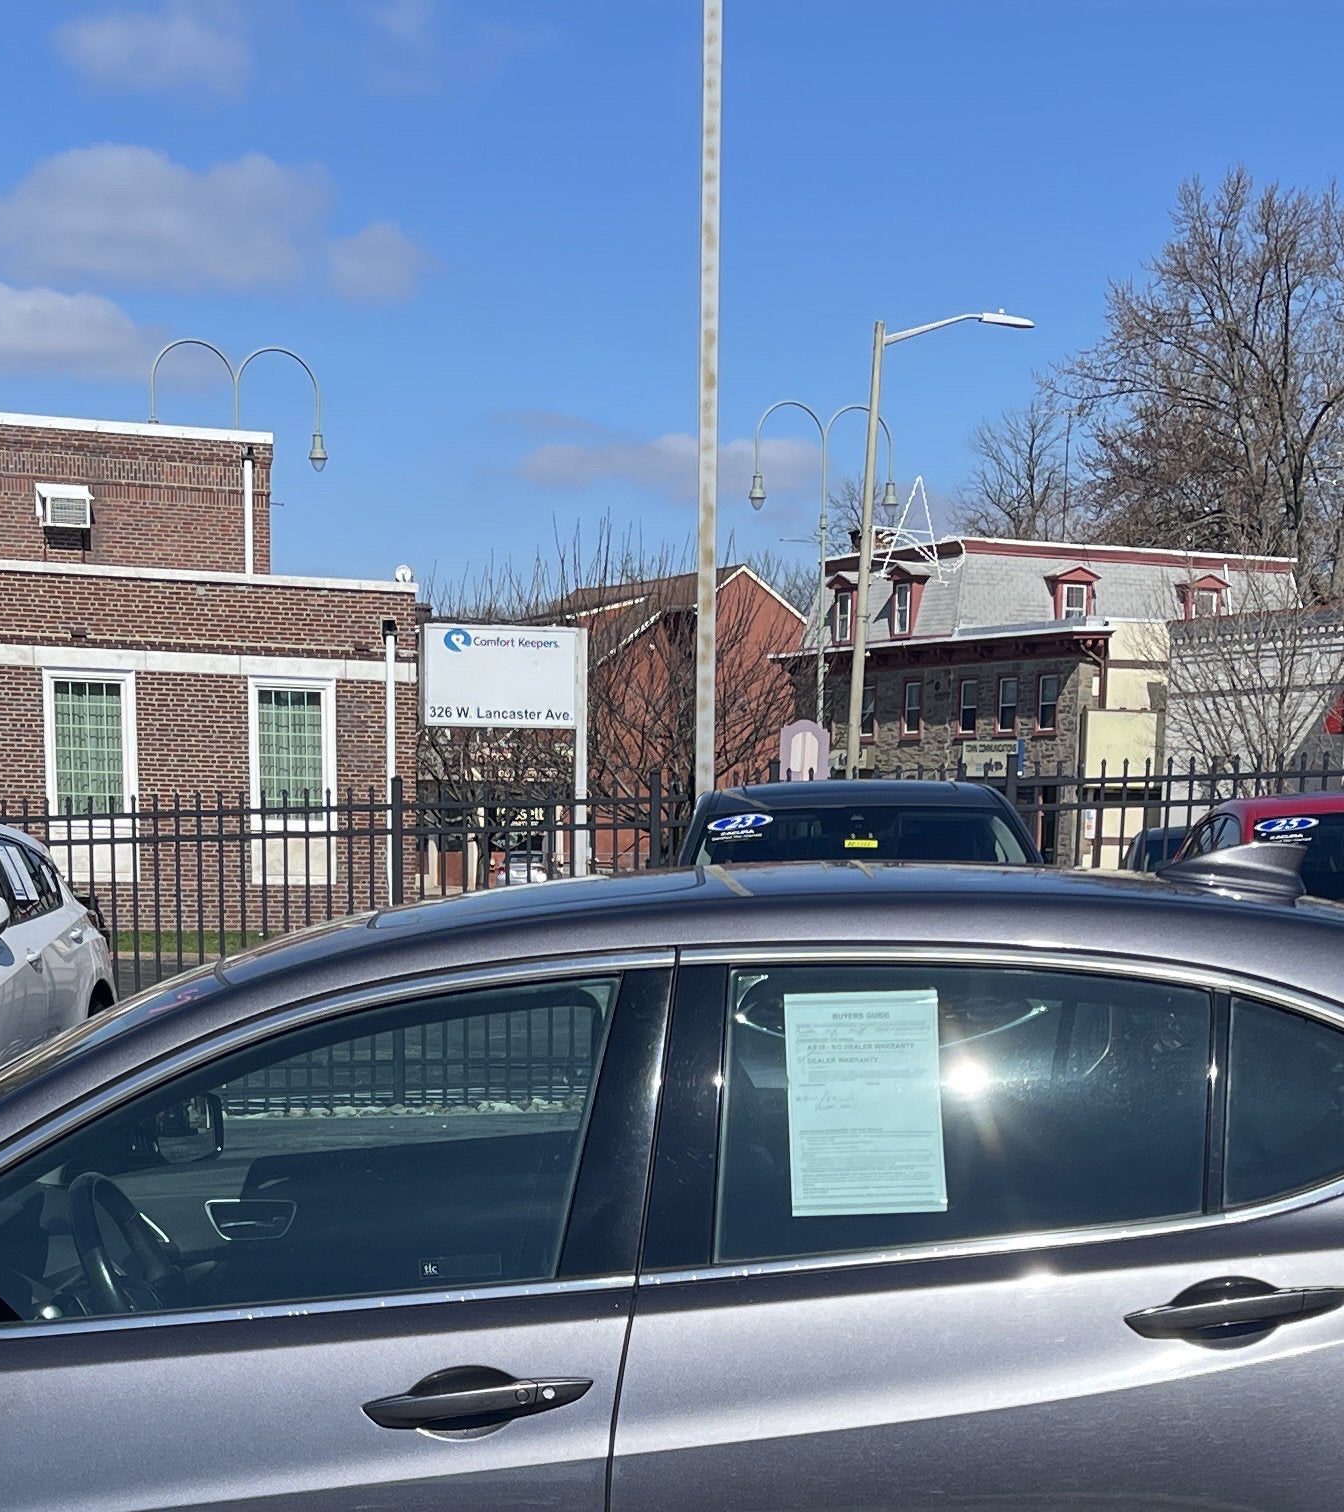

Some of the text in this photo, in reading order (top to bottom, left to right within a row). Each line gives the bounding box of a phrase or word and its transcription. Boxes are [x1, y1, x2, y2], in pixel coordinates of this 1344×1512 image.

[473, 636, 515, 648] Comfort
[429, 706, 453, 719] 326
[476, 707, 542, 720] Lancaster
[544, 709, 574, 721] Ave.
[725, 814, 757, 830] 23
[1272, 817, 1301, 831] 25
[831, 1011, 890, 1020] BUYERS GUIDE
[843, 1043, 873, 1051] DEALER
[874, 1042, 915, 1050] WARRANTY
[807, 1057, 838, 1065] DEALER
